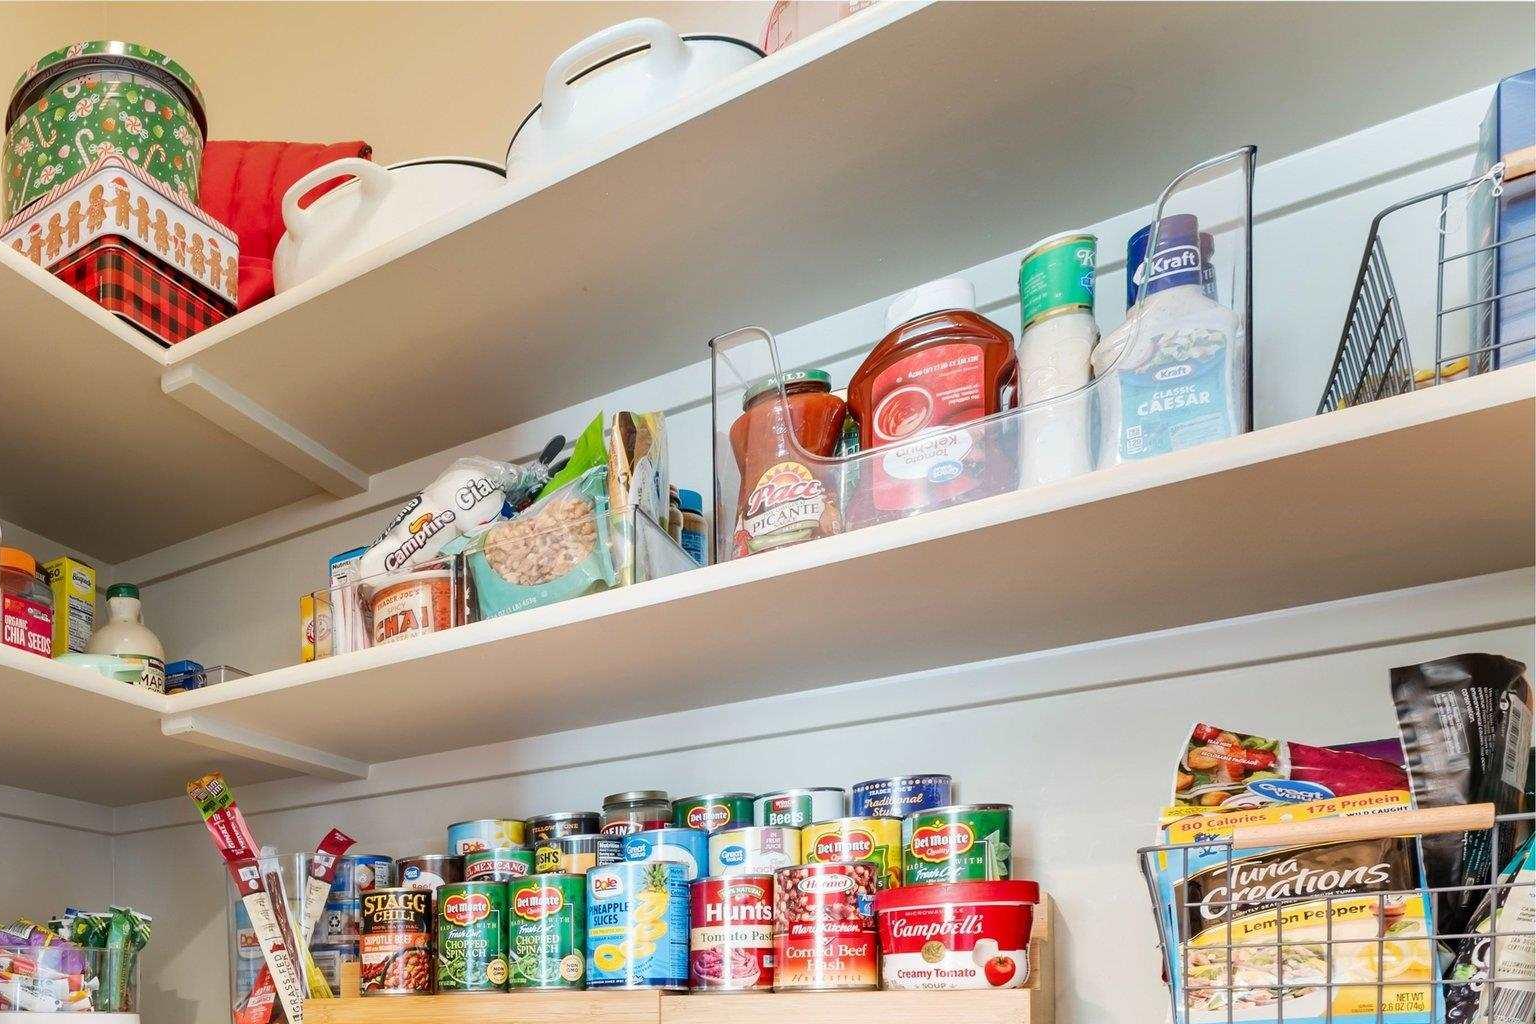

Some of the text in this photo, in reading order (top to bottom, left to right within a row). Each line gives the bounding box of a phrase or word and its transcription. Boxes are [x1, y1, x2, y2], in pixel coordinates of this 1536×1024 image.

[1150, 251, 1197, 277] Kraft
[1160, 366, 1188, 379] Kraft
[1152, 384, 1197, 400] CLASSIC
[1136, 391, 1211, 417] CAESAR
[895, 433, 959, 457] Ketchup
[904, 447, 949, 465] Tomato
[752, 502, 821, 534] PICANTE
[384, 509, 456, 573] Campfire
[401, 588, 421, 600] JOE'S
[386, 601, 408, 613] SPICY
[3, 614, 30, 630] ORGANIC
[376, 606, 430, 643] CHAI
[3, 625, 52, 655] CHIA SEEDS
[864, 794, 924, 810] Traditional
[1306, 793, 1401, 815] 17g Protein
[689, 812, 703, 823] Del
[1368, 805, 1410, 817] CAUGHT
[768, 810, 805, 827] Beets
[1180, 812, 1268, 833] 80 Calories
[462, 842, 486, 853] Dole
[817, 840, 871, 855] Del Monte
[913, 833, 969, 850] Del Monte
[626, 844, 648, 855] Great
[721, 850, 747, 860] Great
[1212, 857, 1299, 888] Tuna
[593, 877, 619, 891] Dole
[803, 876, 850, 891] Hormel
[1199, 862, 1391, 921] Creations
[364, 893, 426, 916] STAGG
[445, 902, 487, 914] Del Monte
[517, 896, 561, 908] Del Monte
[588, 902, 630, 914] PINEAPPLE
[373, 909, 415, 923] CHILI
[593, 914, 619, 926] SLICES
[1243, 902, 1368, 934] Lemon Pepper
[822, 922, 861, 935] Kitchen
[891, 913, 985, 941] Campbell's
[515, 935, 561, 947] CHOPPED
[700, 931, 748, 943] Tomato
[445, 939, 488, 950] CHOPPED
[516, 944, 560, 955] SPINACH
[838, 943, 868, 958] Beef
[445, 949, 487, 959] SPINACH
[806, 958, 846, 972] Hash
[896, 967, 977, 981] Creamy Tomato
[920, 981, 948, 989] SOUP
[1396, 992, 1424, 1003] NET WT
